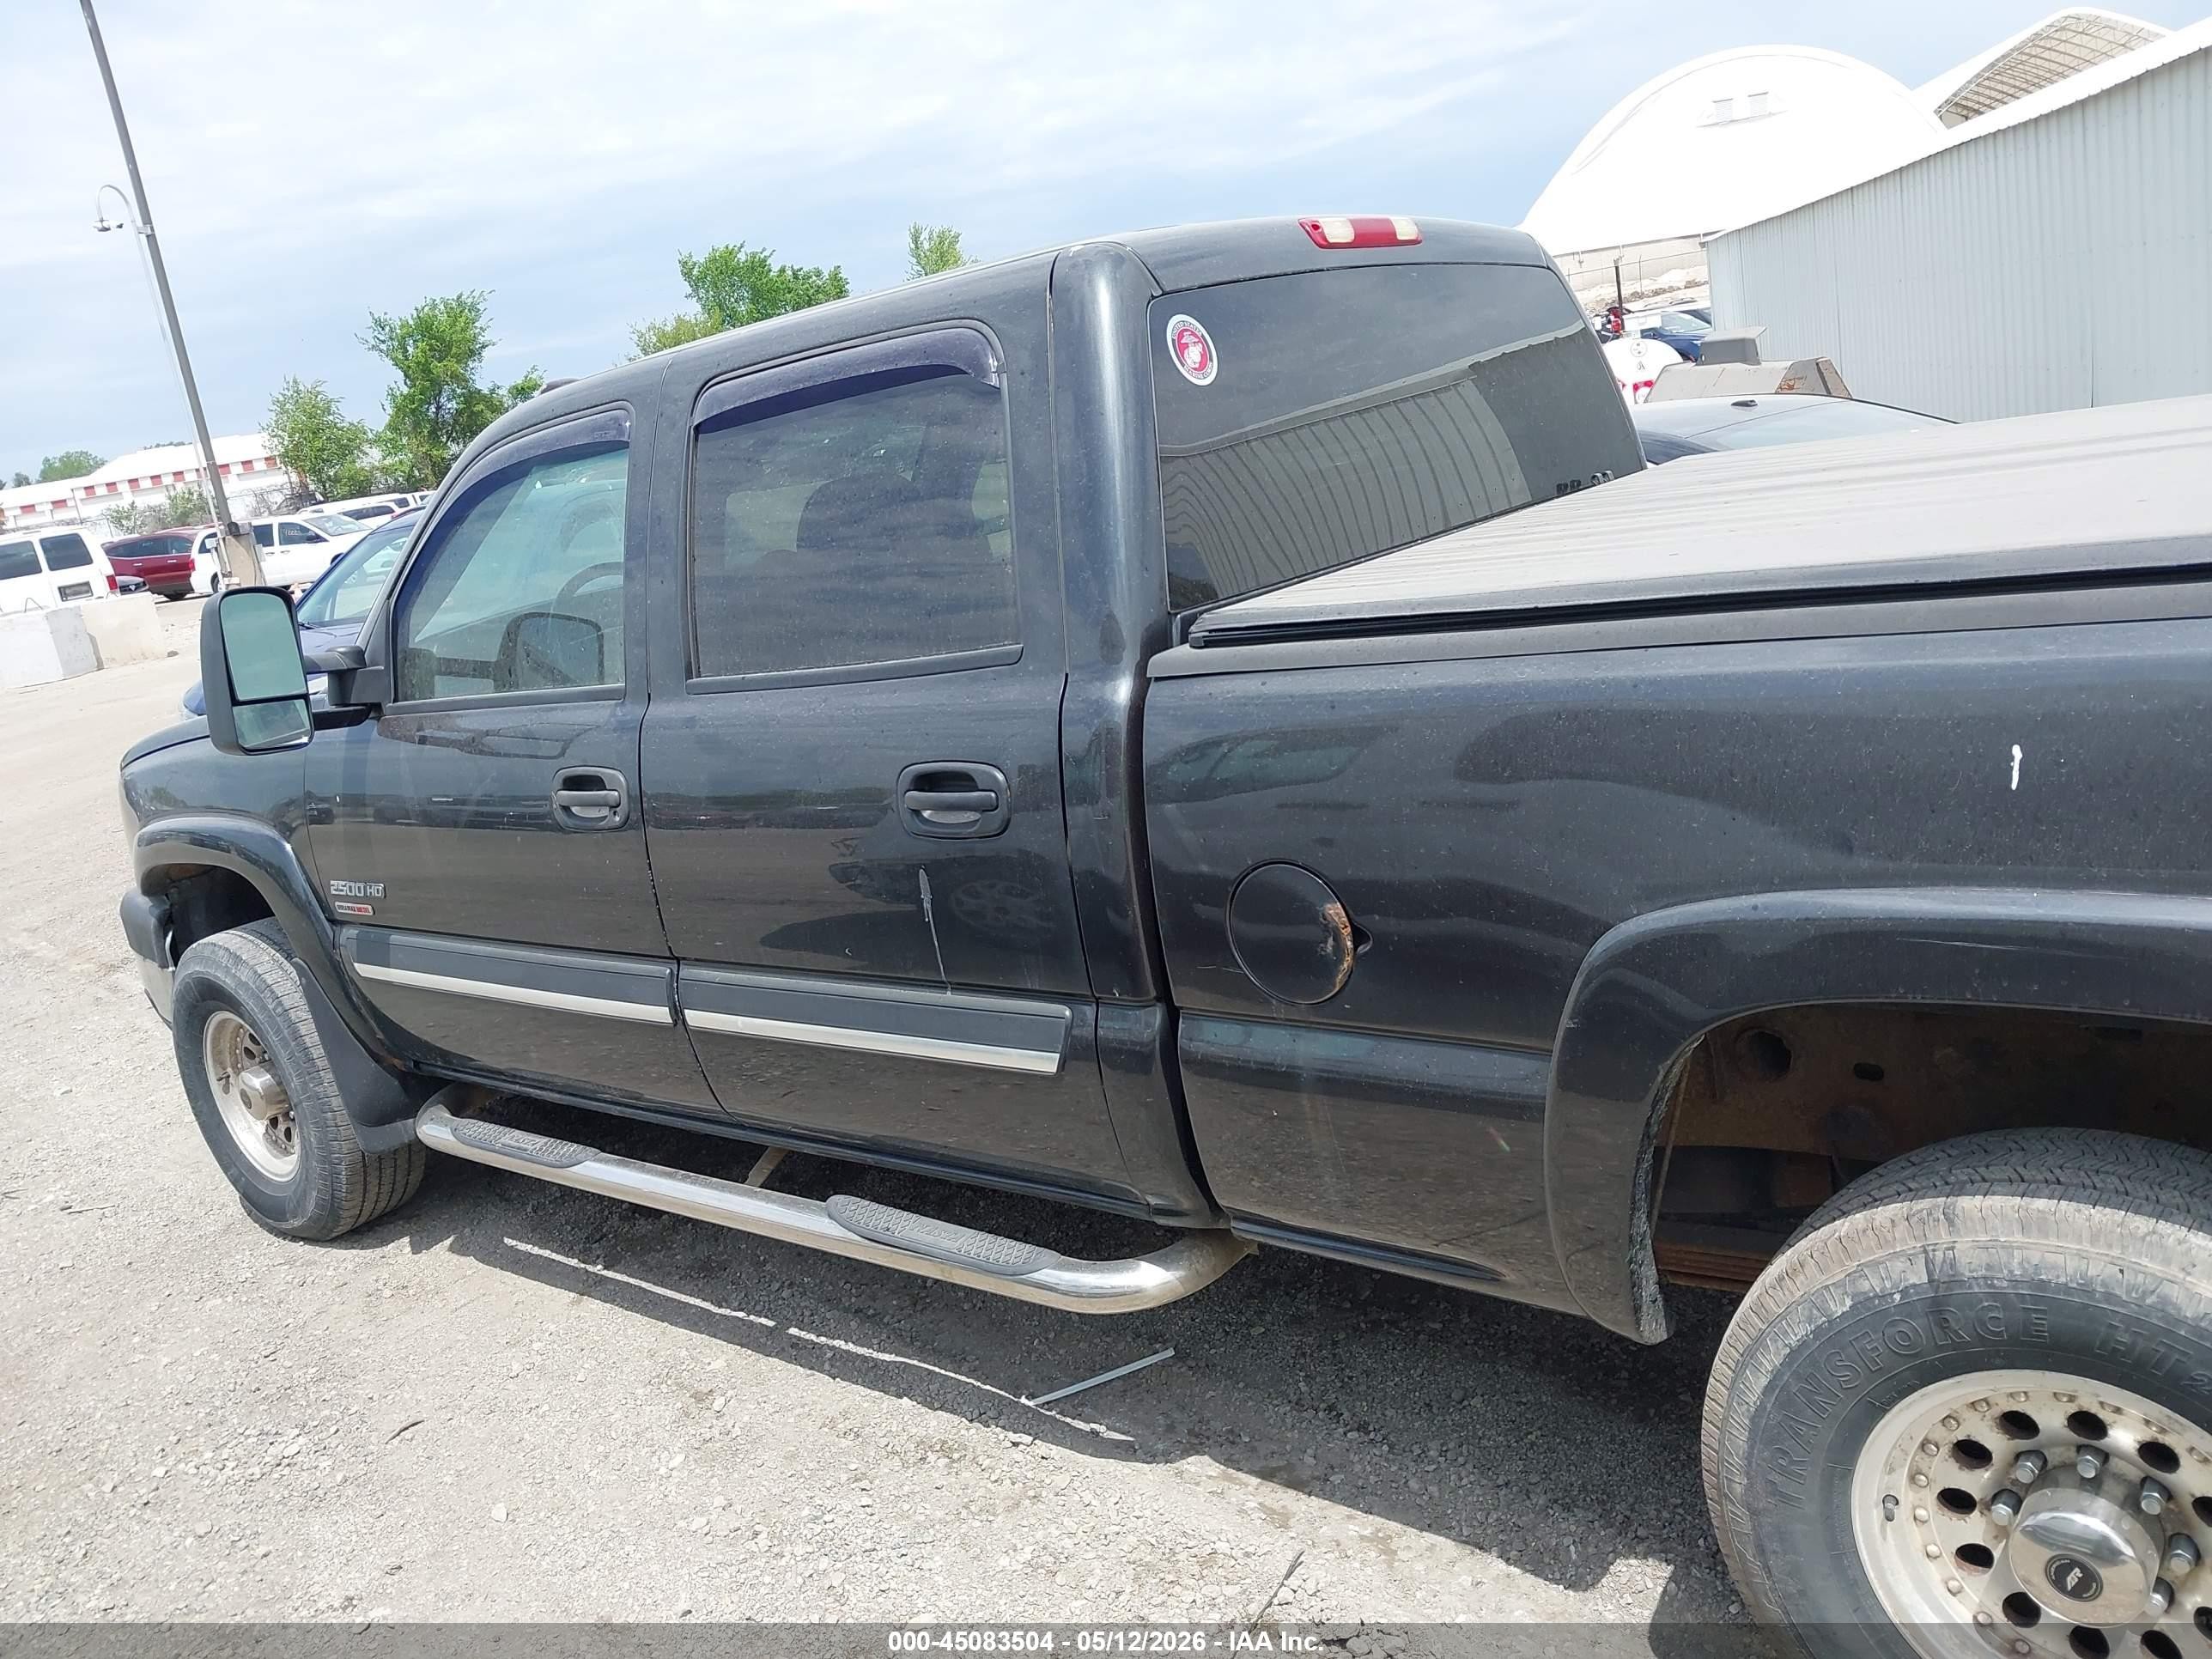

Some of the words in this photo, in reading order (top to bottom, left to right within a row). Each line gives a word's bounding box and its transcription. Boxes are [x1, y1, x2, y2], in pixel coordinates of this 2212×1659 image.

[330, 880, 365, 896] 2500
[367, 884, 382, 897] HD
[1766, 1302, 2051, 1510] TRANSFORCE
